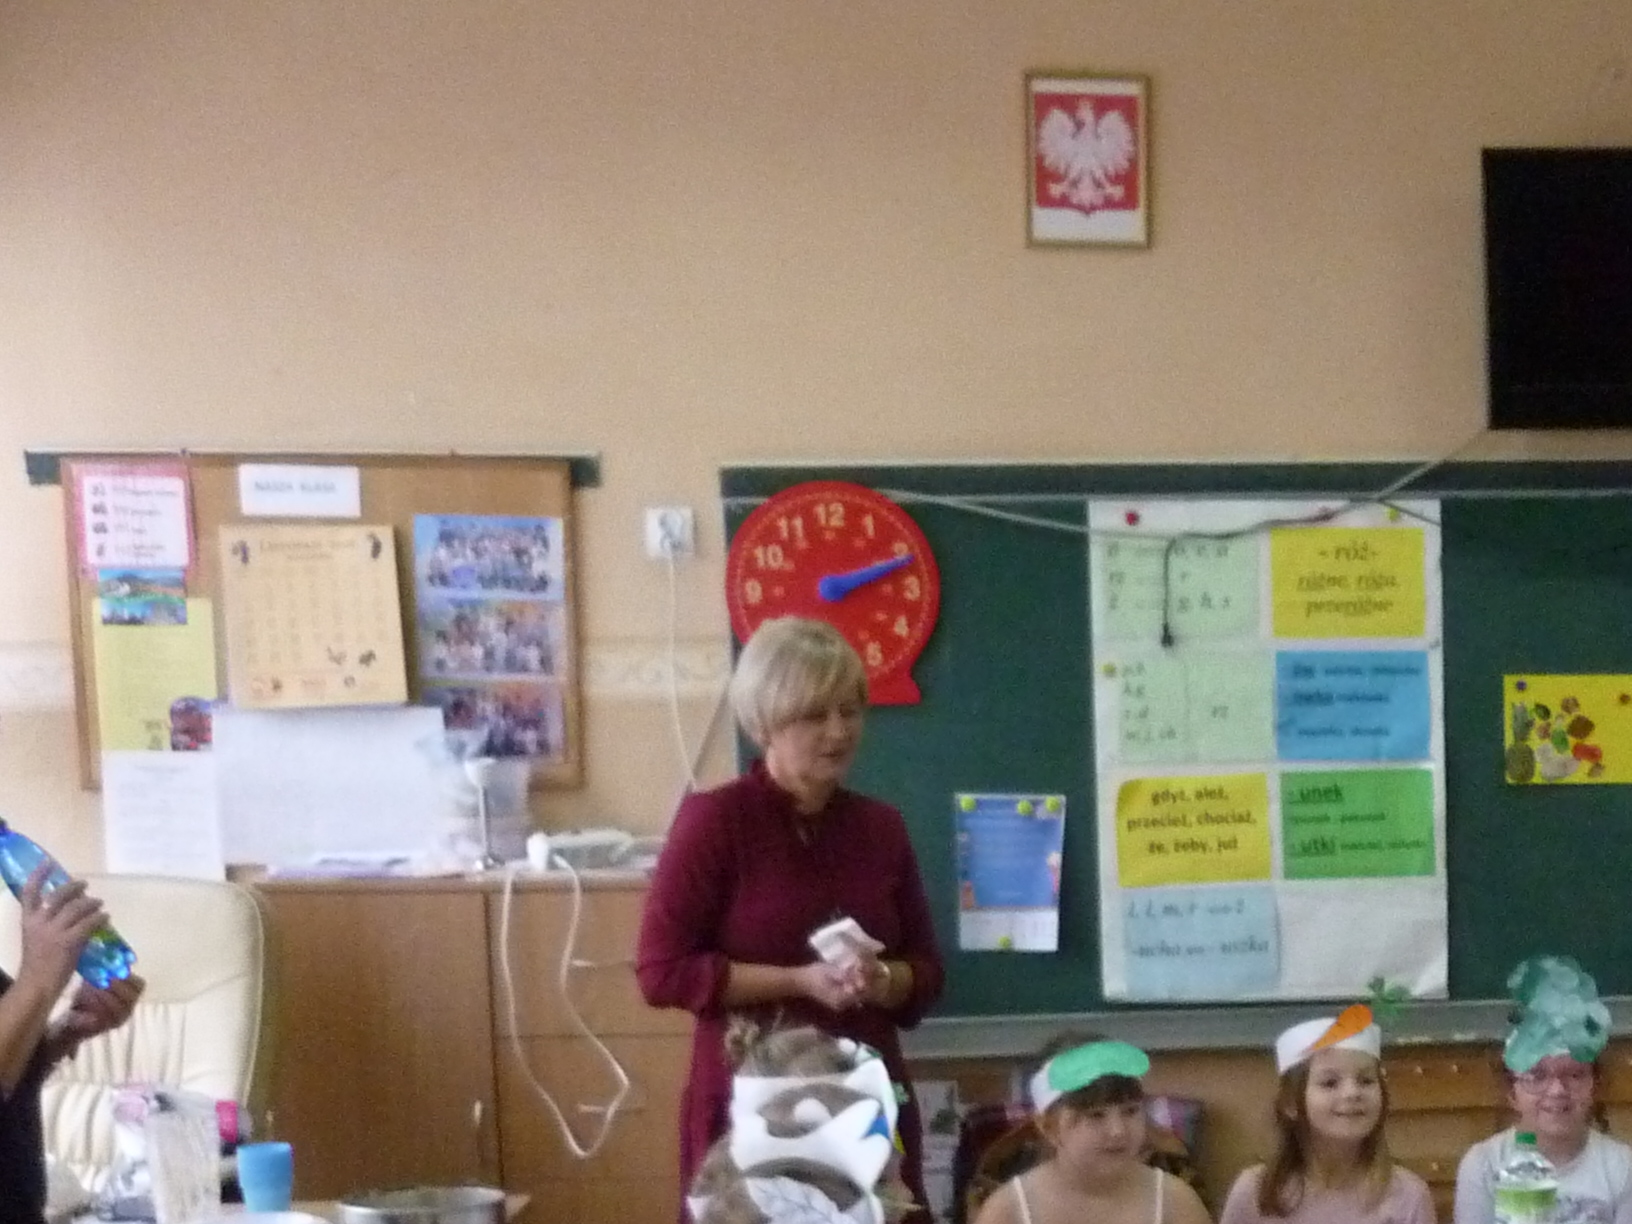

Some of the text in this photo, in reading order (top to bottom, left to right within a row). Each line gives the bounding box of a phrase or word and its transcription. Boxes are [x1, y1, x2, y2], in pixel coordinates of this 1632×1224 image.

[776, 514, 805, 541] 11
[812, 500, 846, 529] 12
[860, 512, 876, 540] 1
[753, 543, 784, 571] 10
[903, 574, 921, 601] 3
[892, 613, 910, 639] 4
